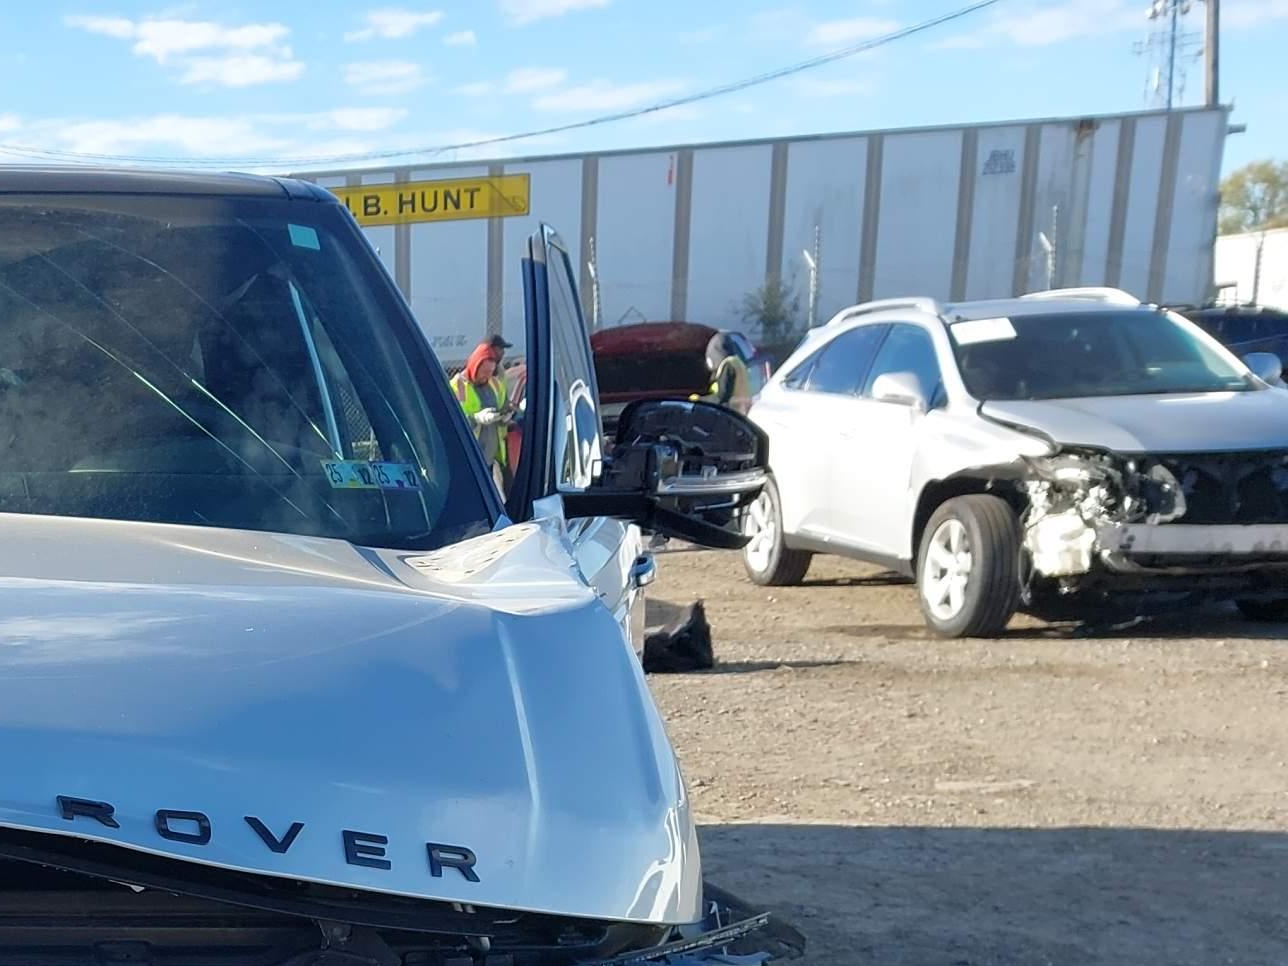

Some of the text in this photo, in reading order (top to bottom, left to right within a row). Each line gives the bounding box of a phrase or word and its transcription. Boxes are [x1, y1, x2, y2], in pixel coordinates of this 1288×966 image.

[398, 187, 481, 214] HUNT
[325, 463, 343, 483] 25
[373, 464, 391, 484] 25
[56, 795, 481, 883] ROVER
